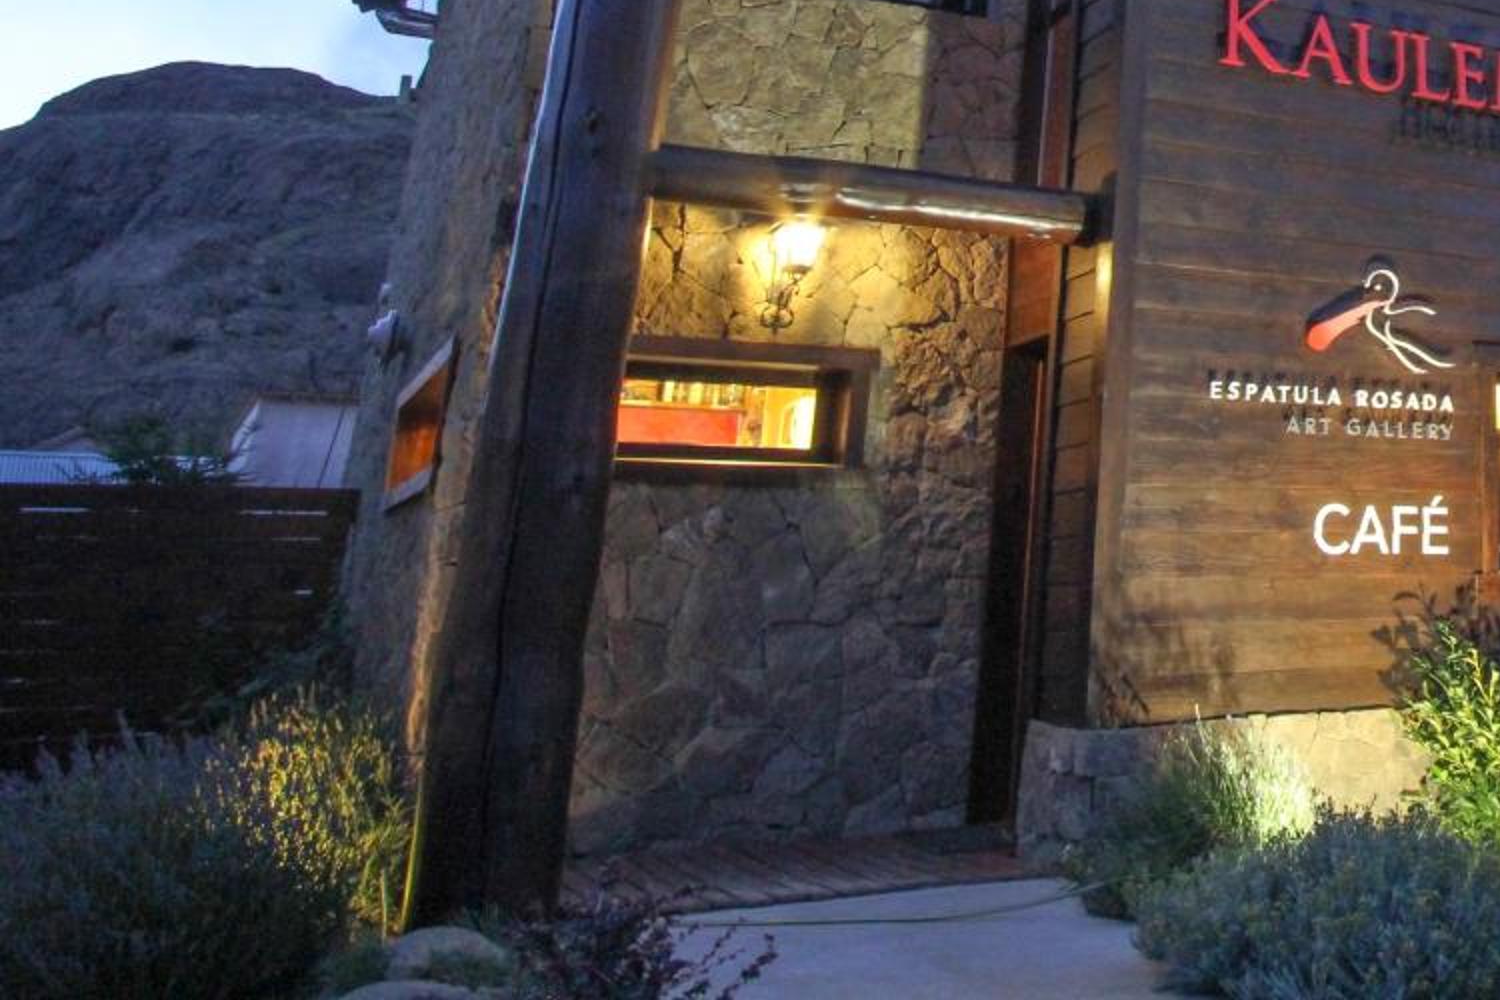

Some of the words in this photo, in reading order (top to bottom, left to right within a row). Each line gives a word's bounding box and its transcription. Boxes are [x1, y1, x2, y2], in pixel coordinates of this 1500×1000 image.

[1209, 381, 1342, 406] ESPATULA
[1355, 390, 1454, 412] ROSADA
[1286, 417, 1331, 435] ART
[1346, 419, 1453, 441] GALLERY
[1313, 495, 1450, 556] CAFÉ
